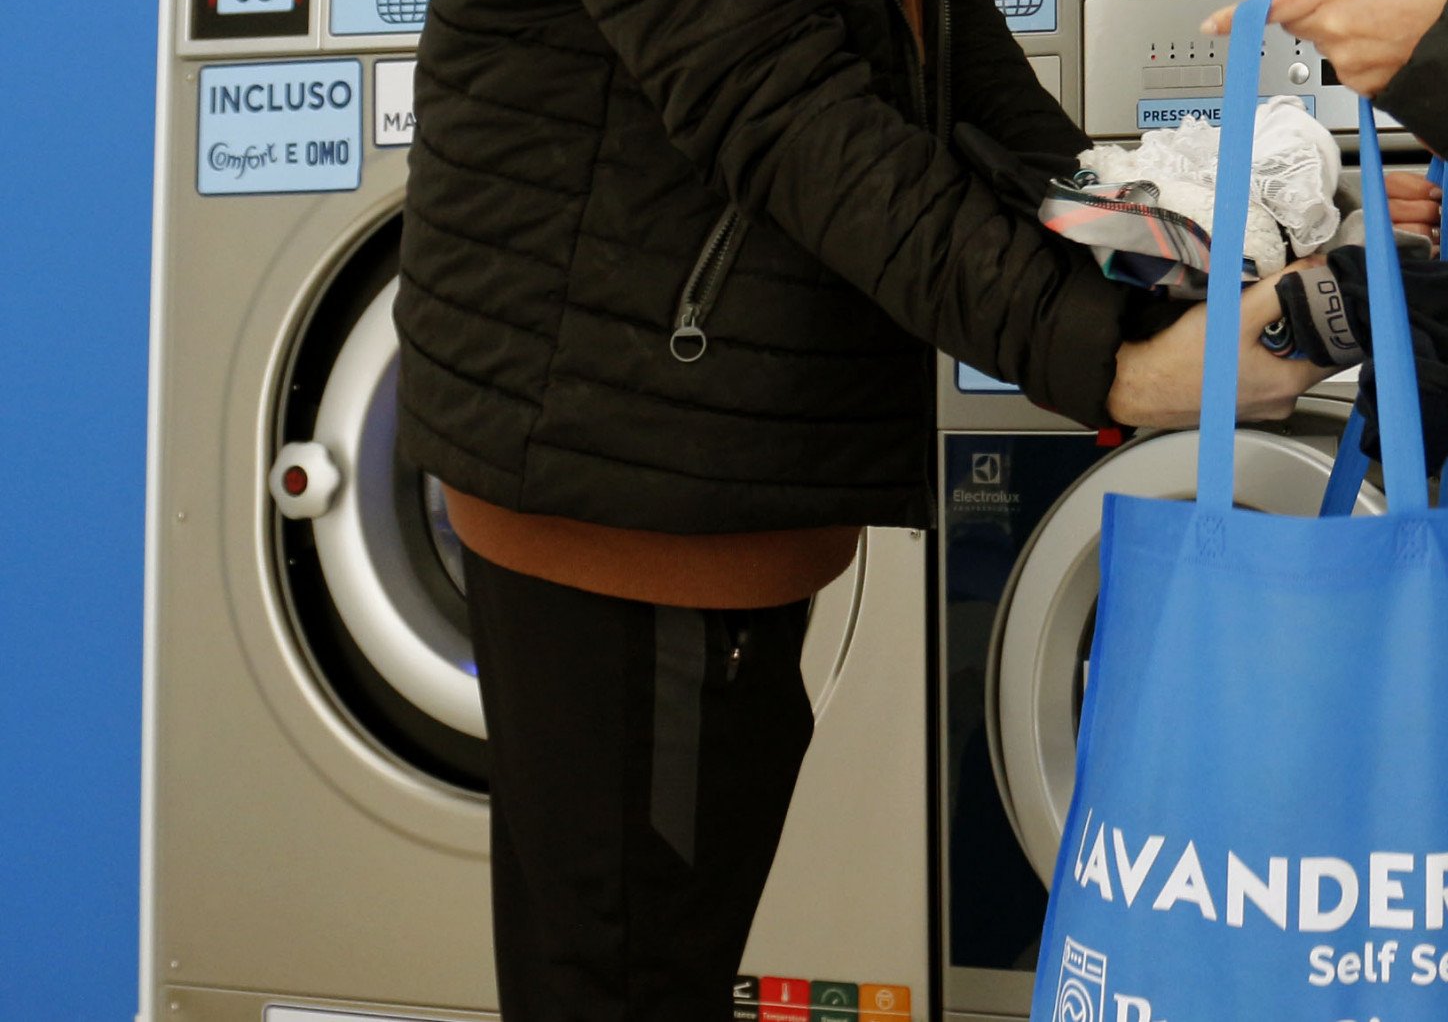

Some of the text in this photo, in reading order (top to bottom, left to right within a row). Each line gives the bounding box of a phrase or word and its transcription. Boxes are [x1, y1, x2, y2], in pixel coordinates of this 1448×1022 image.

[209, 79, 352, 115] INCLUSO
[208, 139, 349, 179] Comfort E OMO
[1308, 940, 1399, 986] Self
